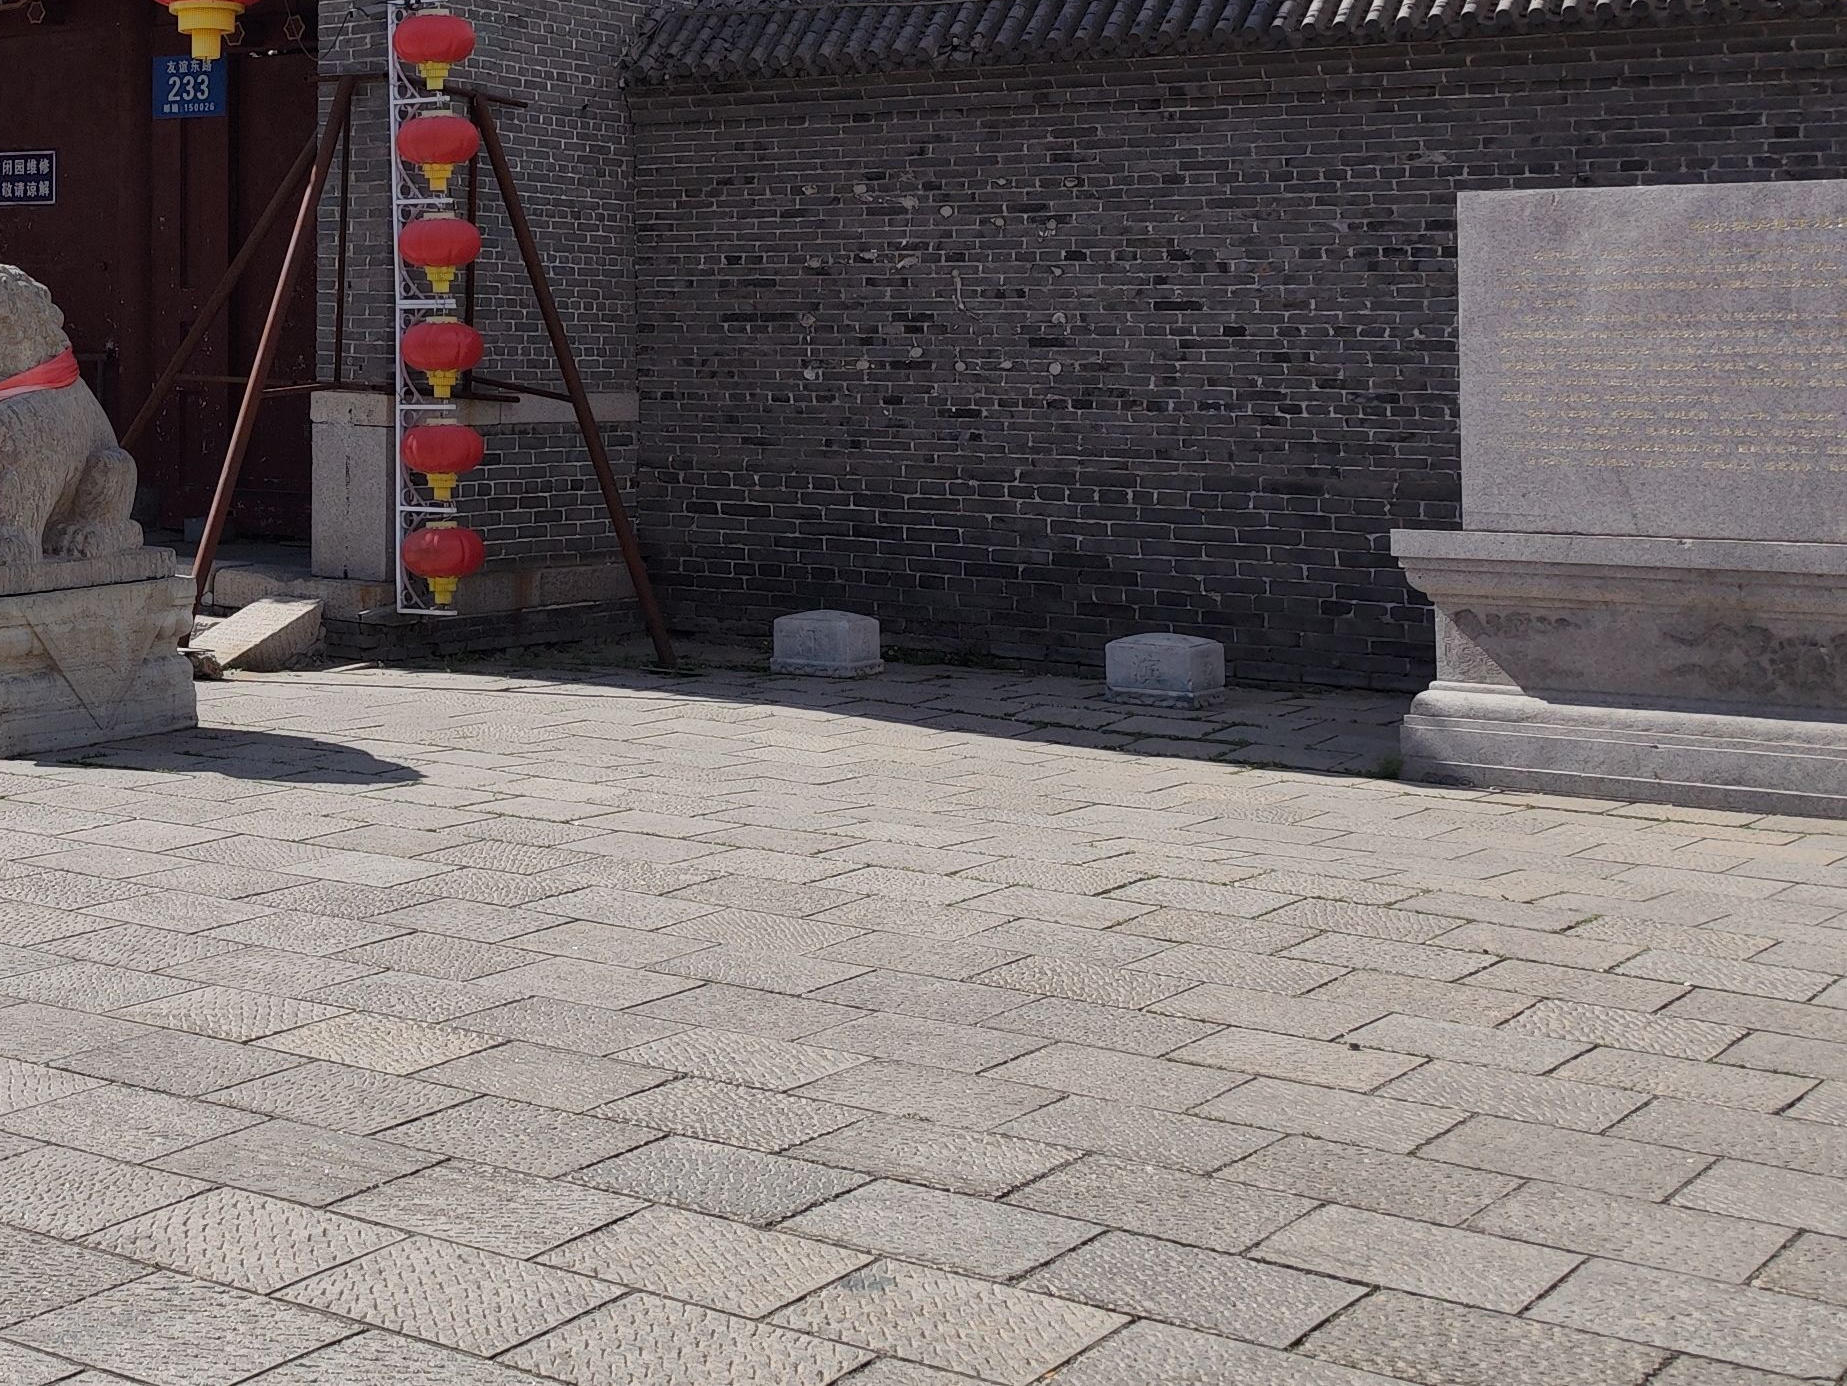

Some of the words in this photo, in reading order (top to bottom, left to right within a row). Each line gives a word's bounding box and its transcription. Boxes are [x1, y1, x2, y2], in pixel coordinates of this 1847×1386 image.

[167, 60, 212, 73] 友谊东路
[168, 75, 209, 101] 233
[2, 158, 49, 175] 闭园维修
[2, 181, 49, 197] 敬请谅解
